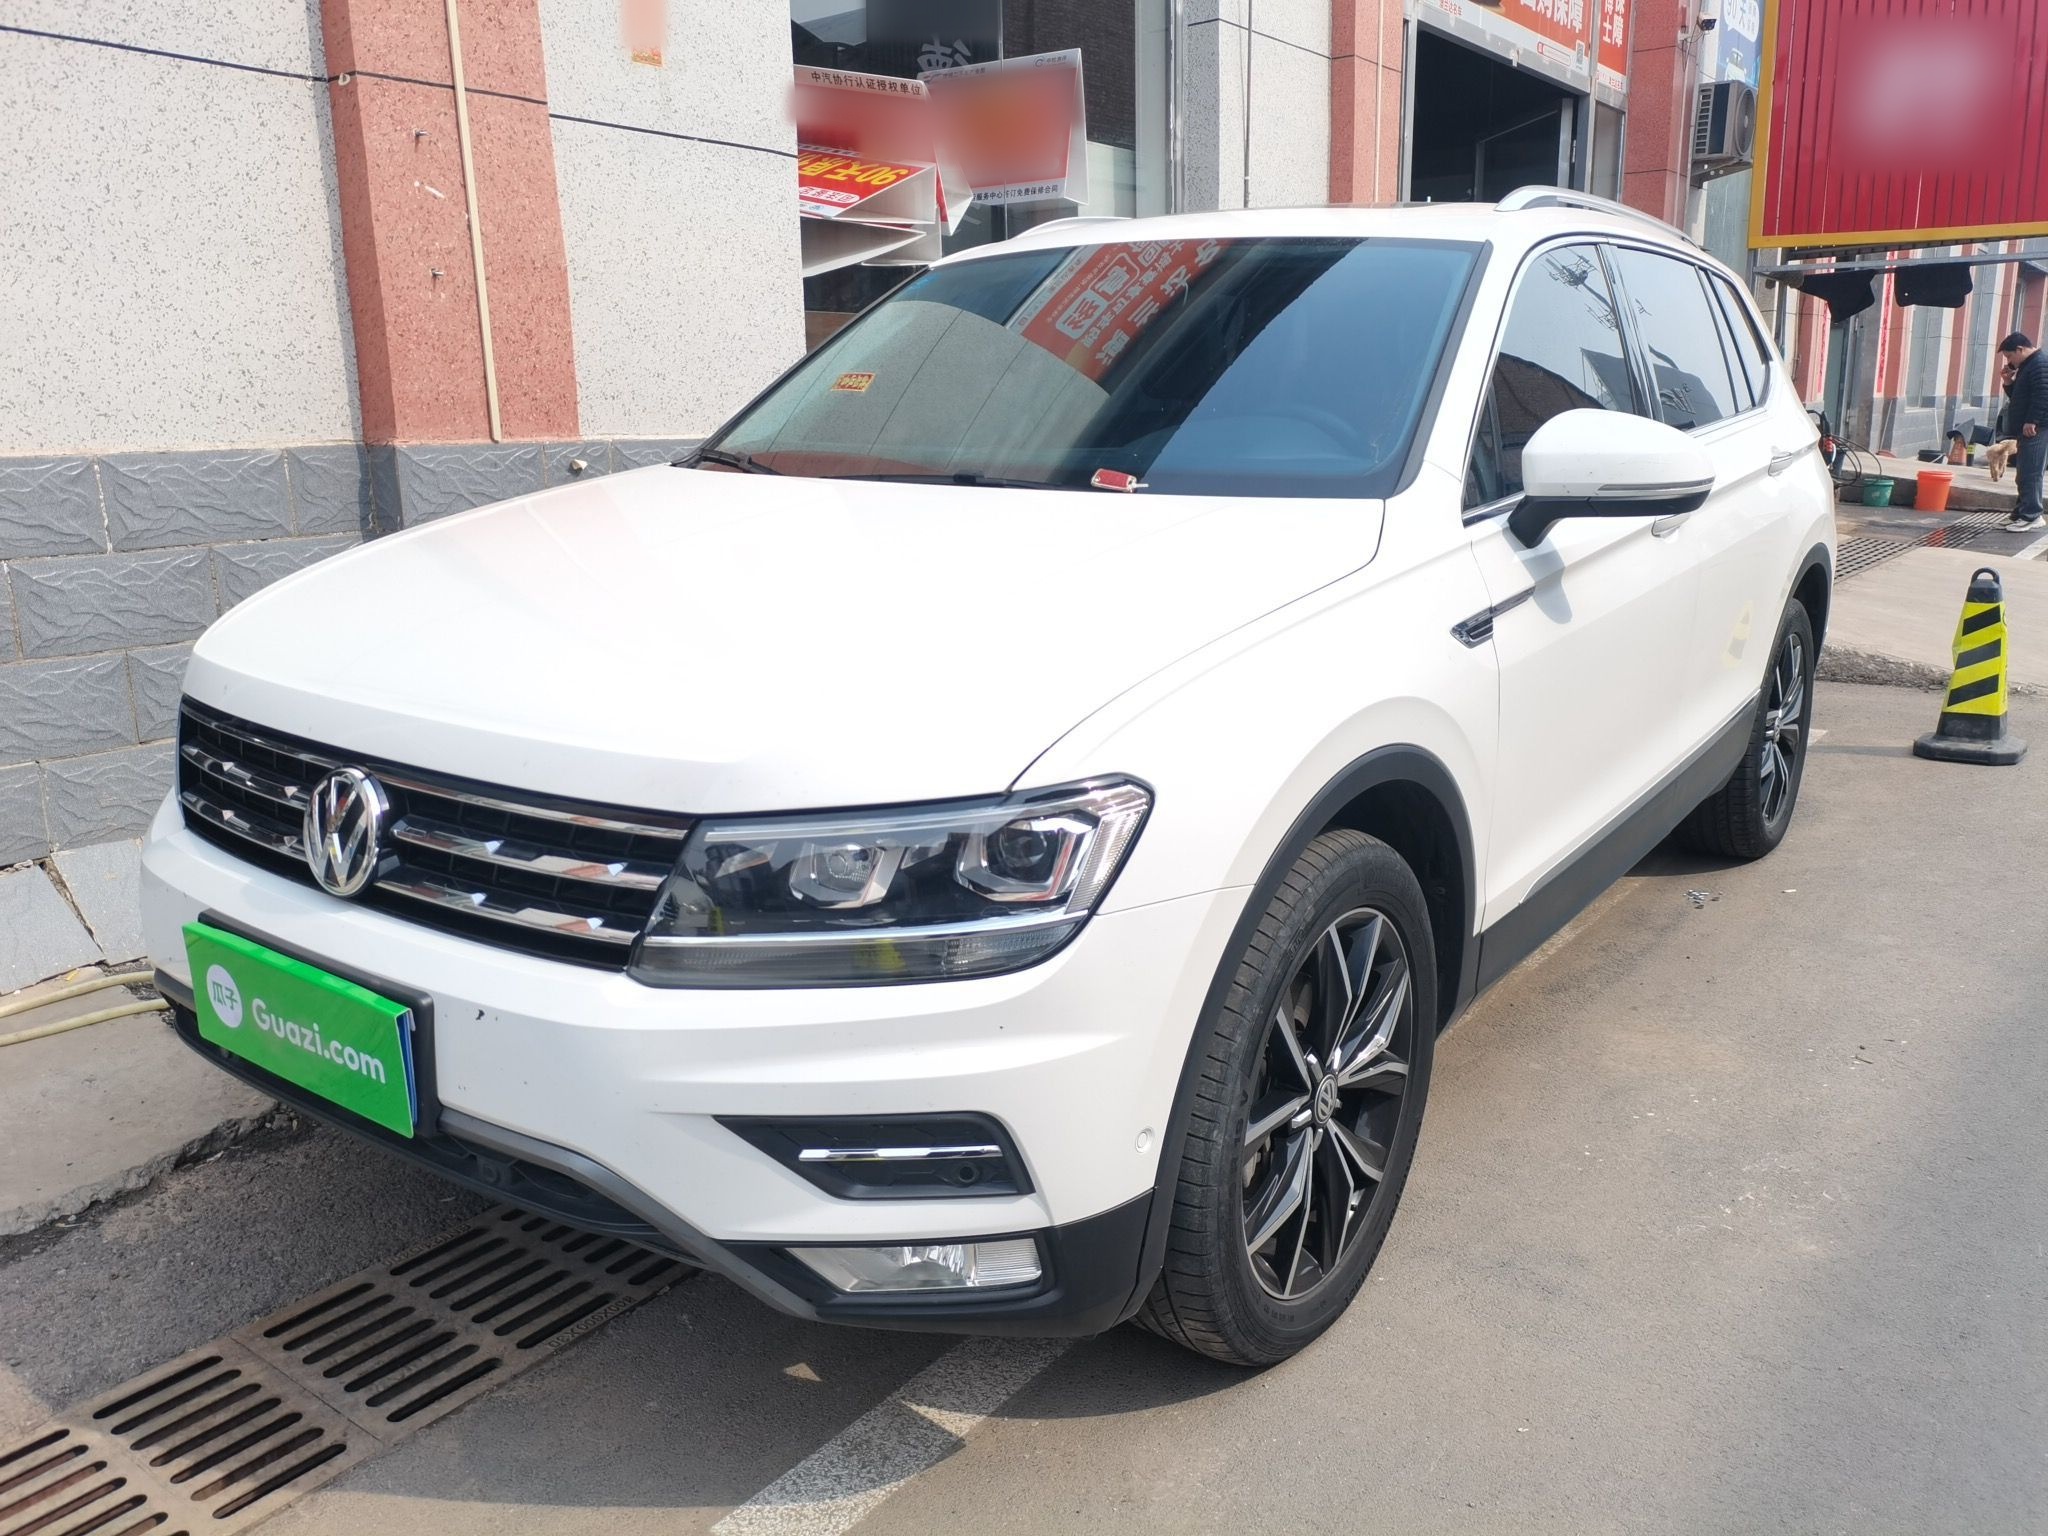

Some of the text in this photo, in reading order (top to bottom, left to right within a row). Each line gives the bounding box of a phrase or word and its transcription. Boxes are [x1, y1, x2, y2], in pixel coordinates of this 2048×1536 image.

[810, 70, 921, 96] 中汽协行认证授权单位
[211, 980, 239, 1011] 瓜子
[251, 998, 387, 1085] Guazi.com
